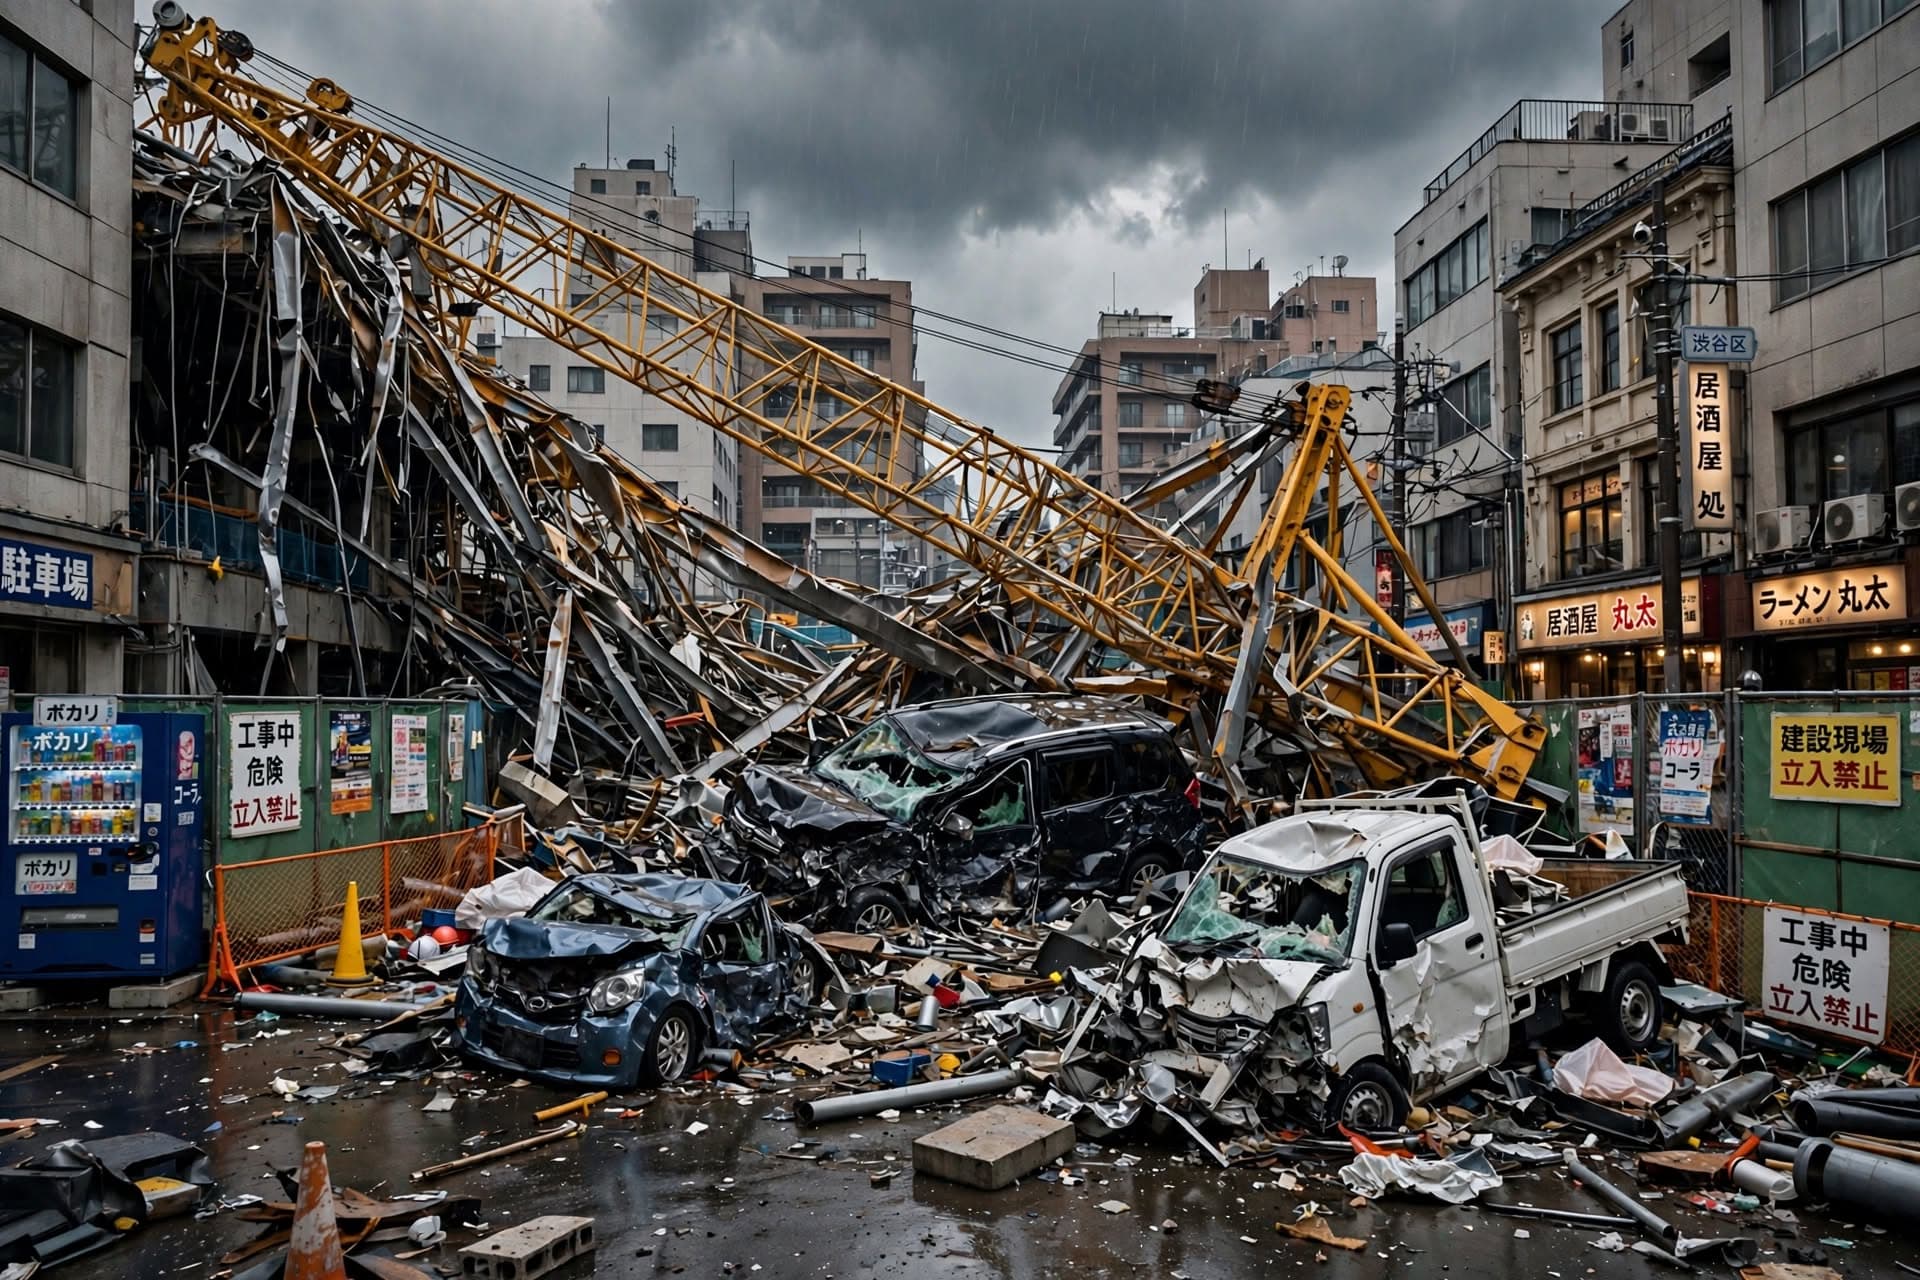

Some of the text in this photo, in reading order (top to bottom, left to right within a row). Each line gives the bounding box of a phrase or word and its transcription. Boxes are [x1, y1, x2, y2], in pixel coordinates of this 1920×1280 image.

[1692, 334, 1746, 352] 渋谷区
[1, 547, 88, 601] 駐車場
[1546, 604, 1598, 637] 居酒屋
[1612, 595, 1657, 631] 丸太
[238, 719, 294, 748] 工事中
[1781, 724, 1889, 754] 建設現場
[247, 755, 283, 787] 危険
[1665, 762, 1700, 780] コーラ
[1780, 759, 1889, 790] 立入禁止
[233, 793, 299, 828] 立入禁止
[1779, 917, 1867, 958] 工事中
[1792, 953, 1851, 992] 危険
[1769, 983, 1879, 1035] 立入禁止
